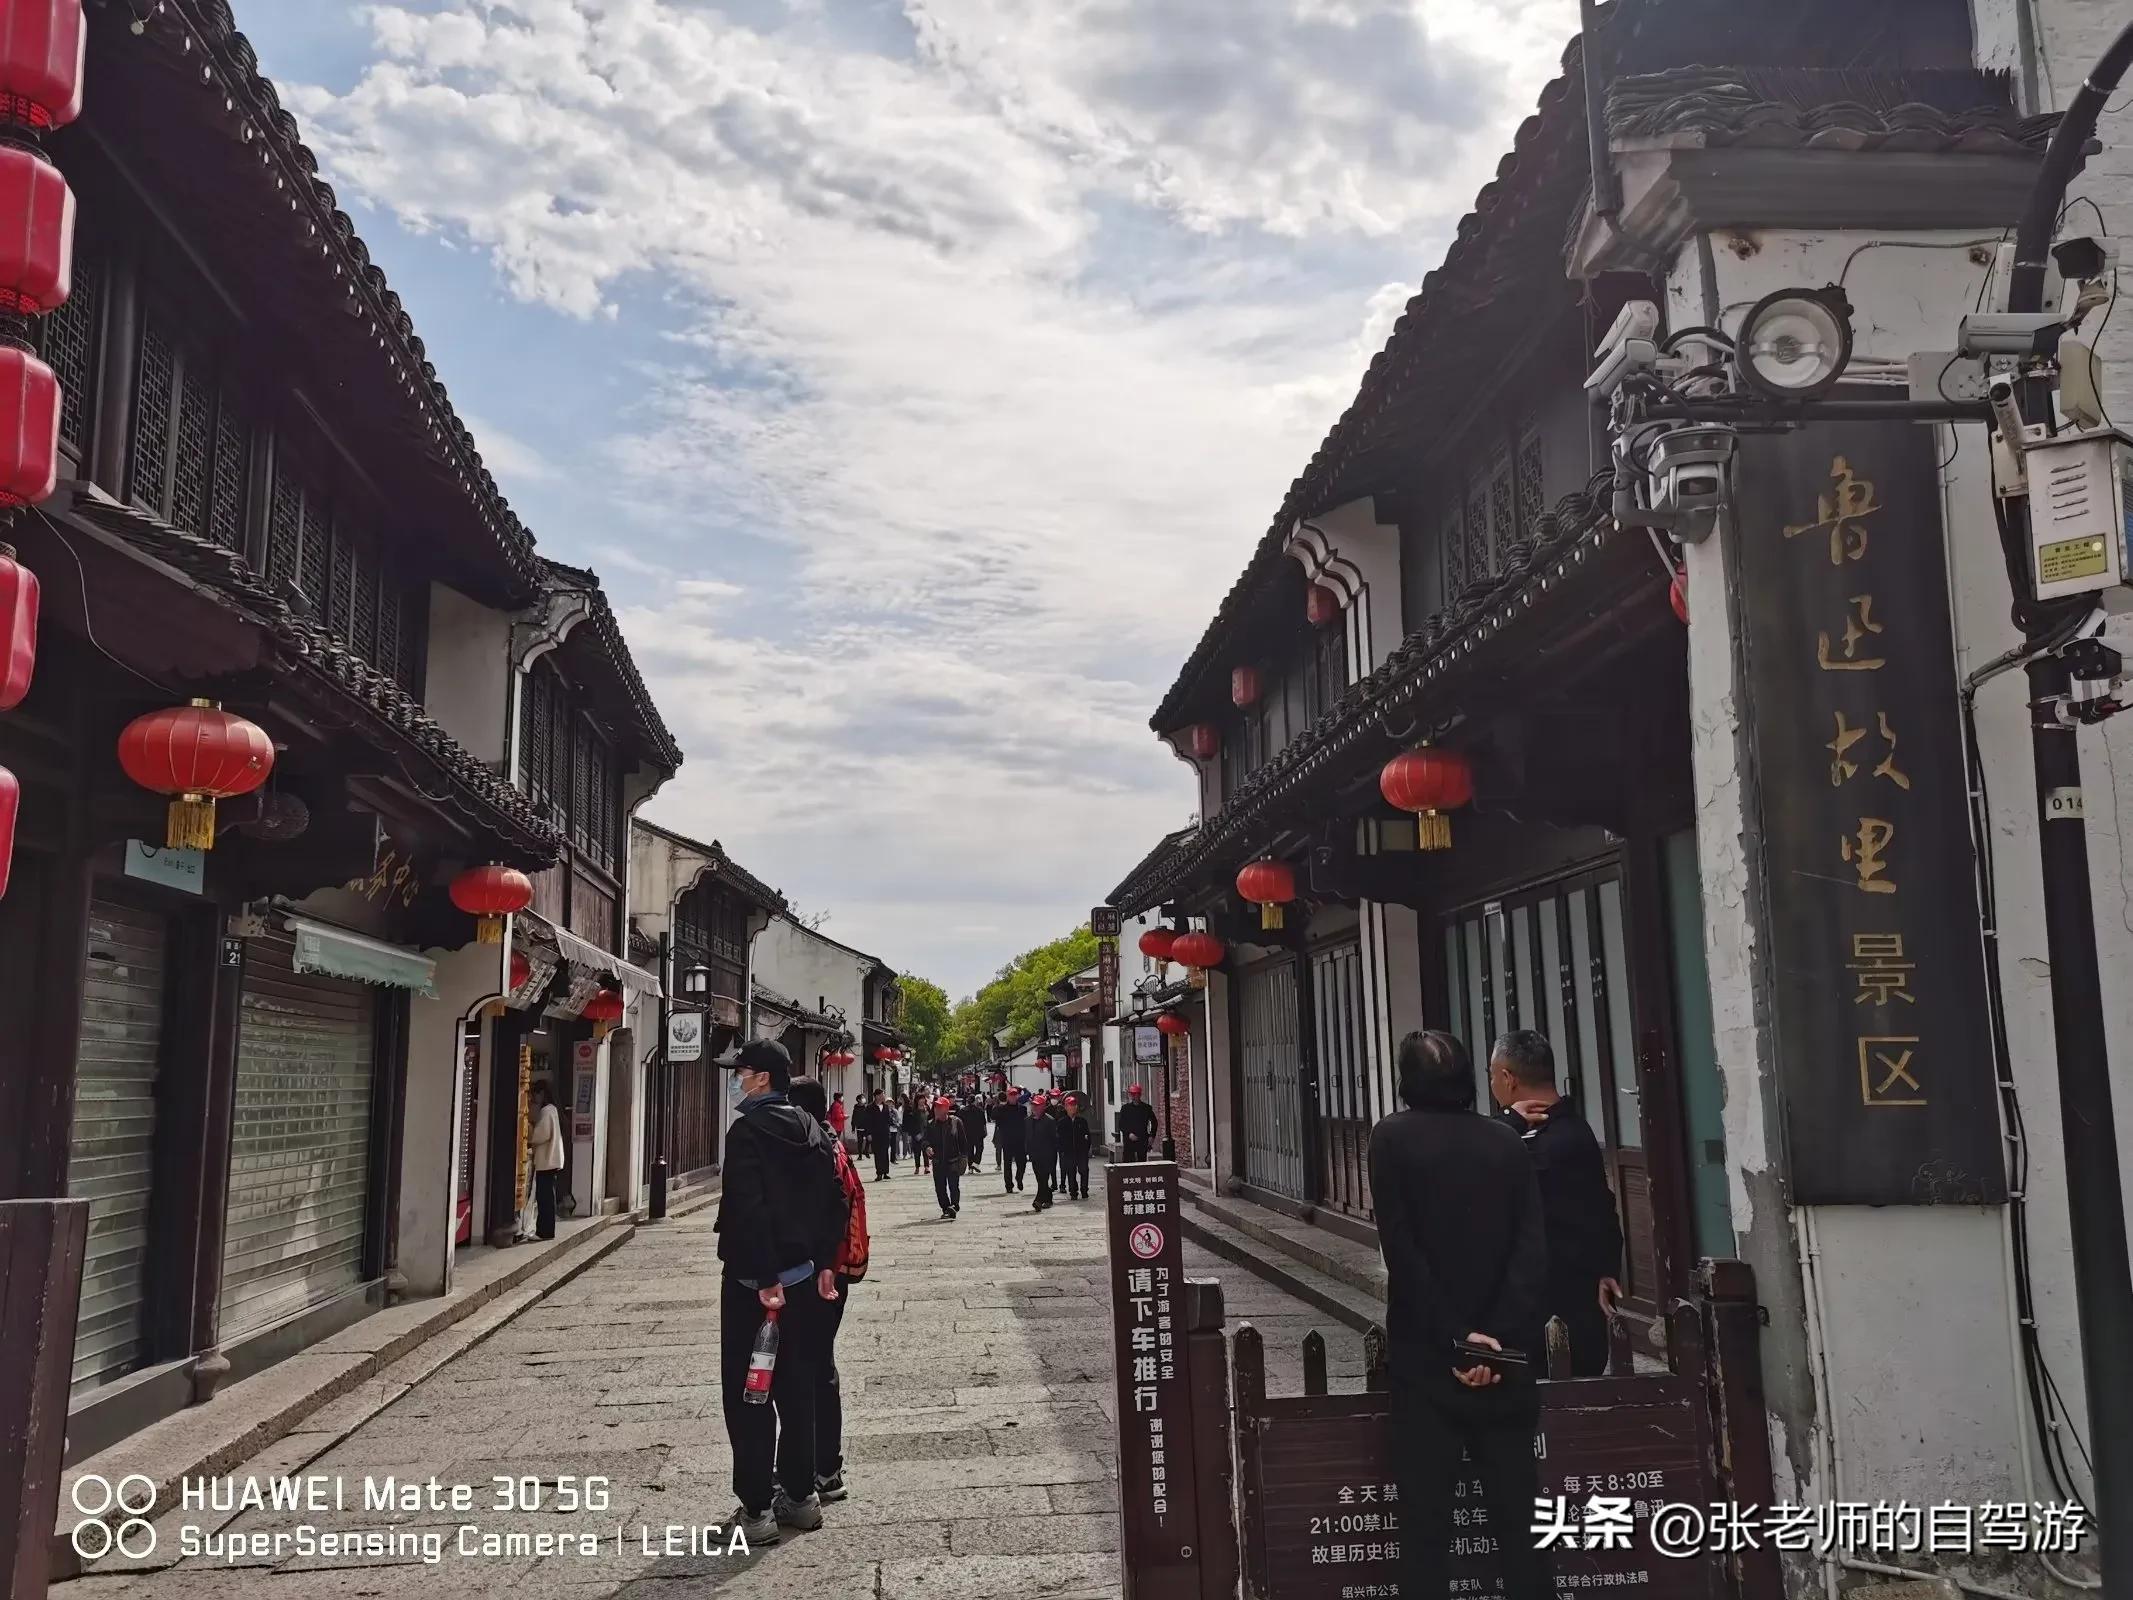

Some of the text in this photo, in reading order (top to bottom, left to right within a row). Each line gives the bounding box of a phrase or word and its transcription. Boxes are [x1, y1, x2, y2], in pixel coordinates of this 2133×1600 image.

[1122, 1189, 1166, 1202] 鲁迅故里
[1123, 1204, 1166, 1215] 新建路口
[1156, 1267, 1174, 1379] 为了游客的安全
[1128, 1268, 1158, 1412] 请下车推行
[1310, 1512, 1400, 1534] 21:00禁止
[1312, 1541, 1400, 1564] 故里历史街
